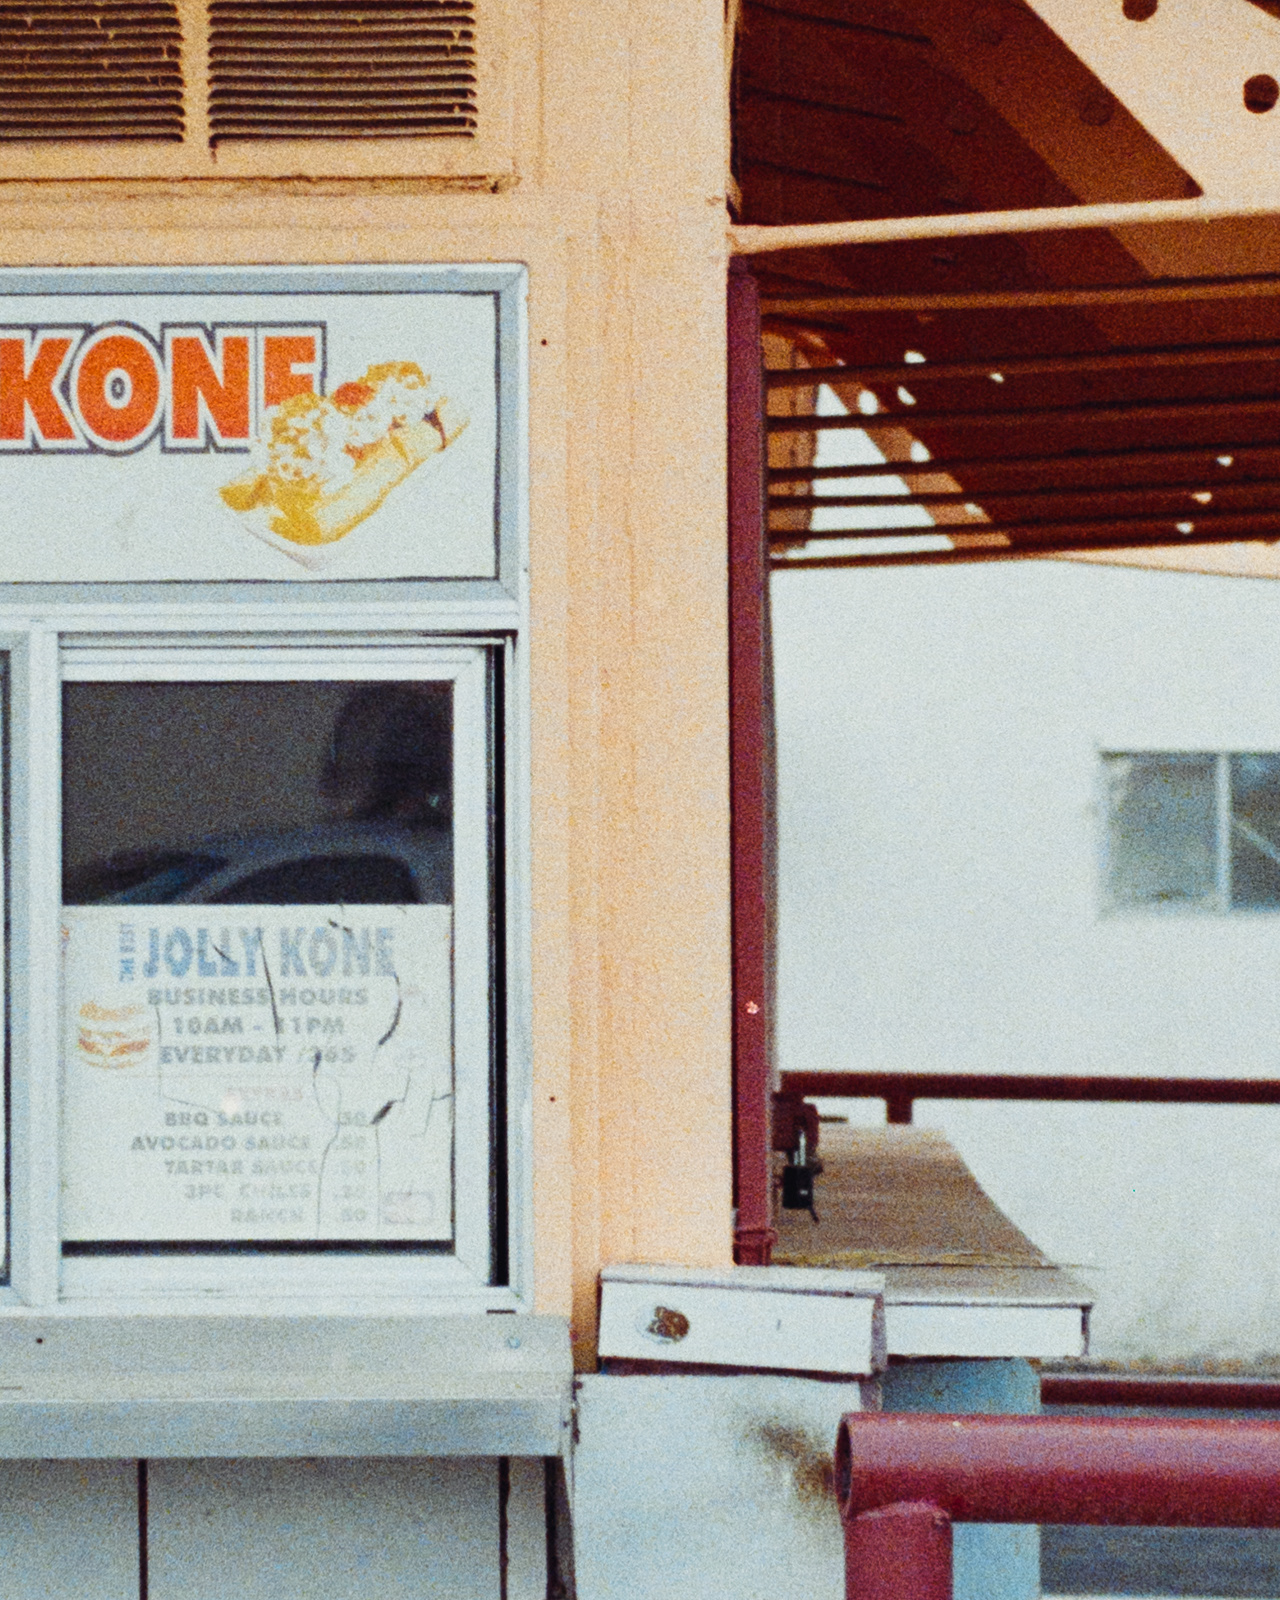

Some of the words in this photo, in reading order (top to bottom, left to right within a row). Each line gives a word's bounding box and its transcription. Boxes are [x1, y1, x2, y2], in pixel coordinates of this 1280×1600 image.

[142, 926, 264, 979] JOLLY
[279, 926, 396, 979] KONE
[148, 987, 272, 1006] BUSINESS
[279, 987, 369, 1006] HOURS
[173, 1016, 244, 1035] 10AM
[274, 1016, 345, 1035] 11PM
[161, 1045, 286, 1064] EVERYDAY
[164, 1111, 209, 1127] BBQ
[218, 1111, 282, 1127] SAUCE
[130, 1135, 237, 1151] AVOCADO
[245, 1135, 311, 1151] SAUCE
[164, 1159, 244, 1175] TARTAR
[252, 1159, 318, 1175] SAUCE
